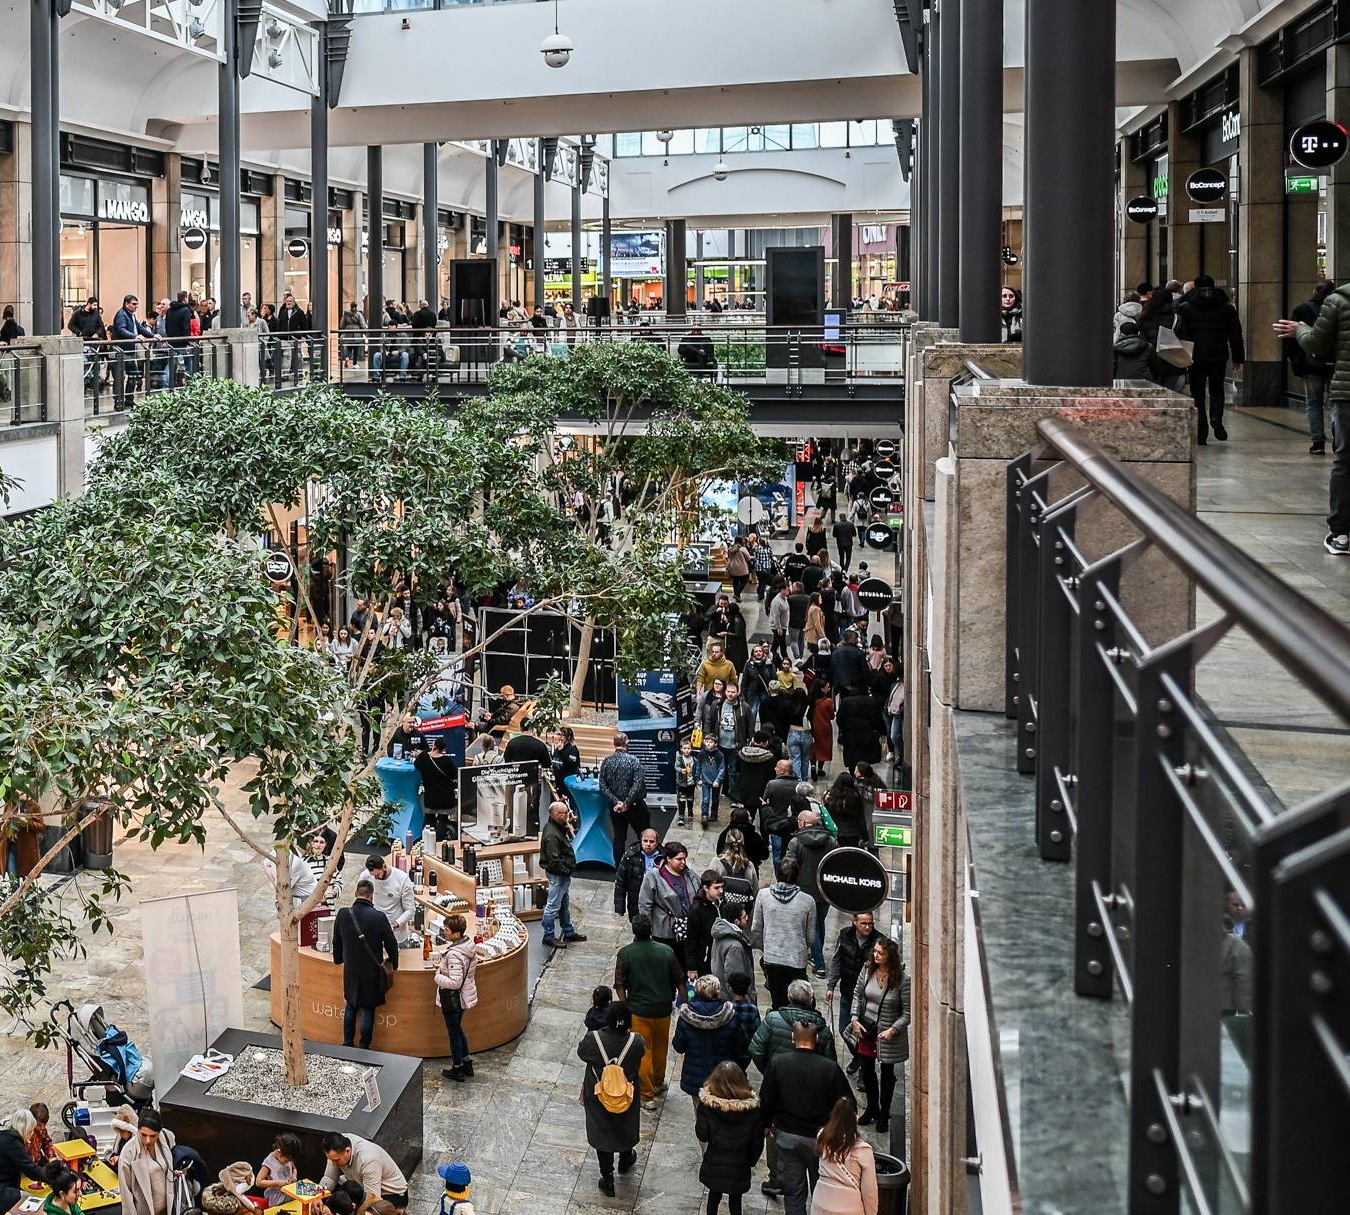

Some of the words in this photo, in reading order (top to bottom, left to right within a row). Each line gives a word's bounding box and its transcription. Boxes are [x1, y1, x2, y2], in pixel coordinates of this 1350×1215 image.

[1190, 181, 1225, 190] BoConcept
[107, 199, 148, 223] MANGO
[1128, 206, 1157, 214] BoConcept
[862, 226, 887, 244] ONLY
[823, 873, 858, 886] MICHAEL
[859, 878, 882, 888] KORS
